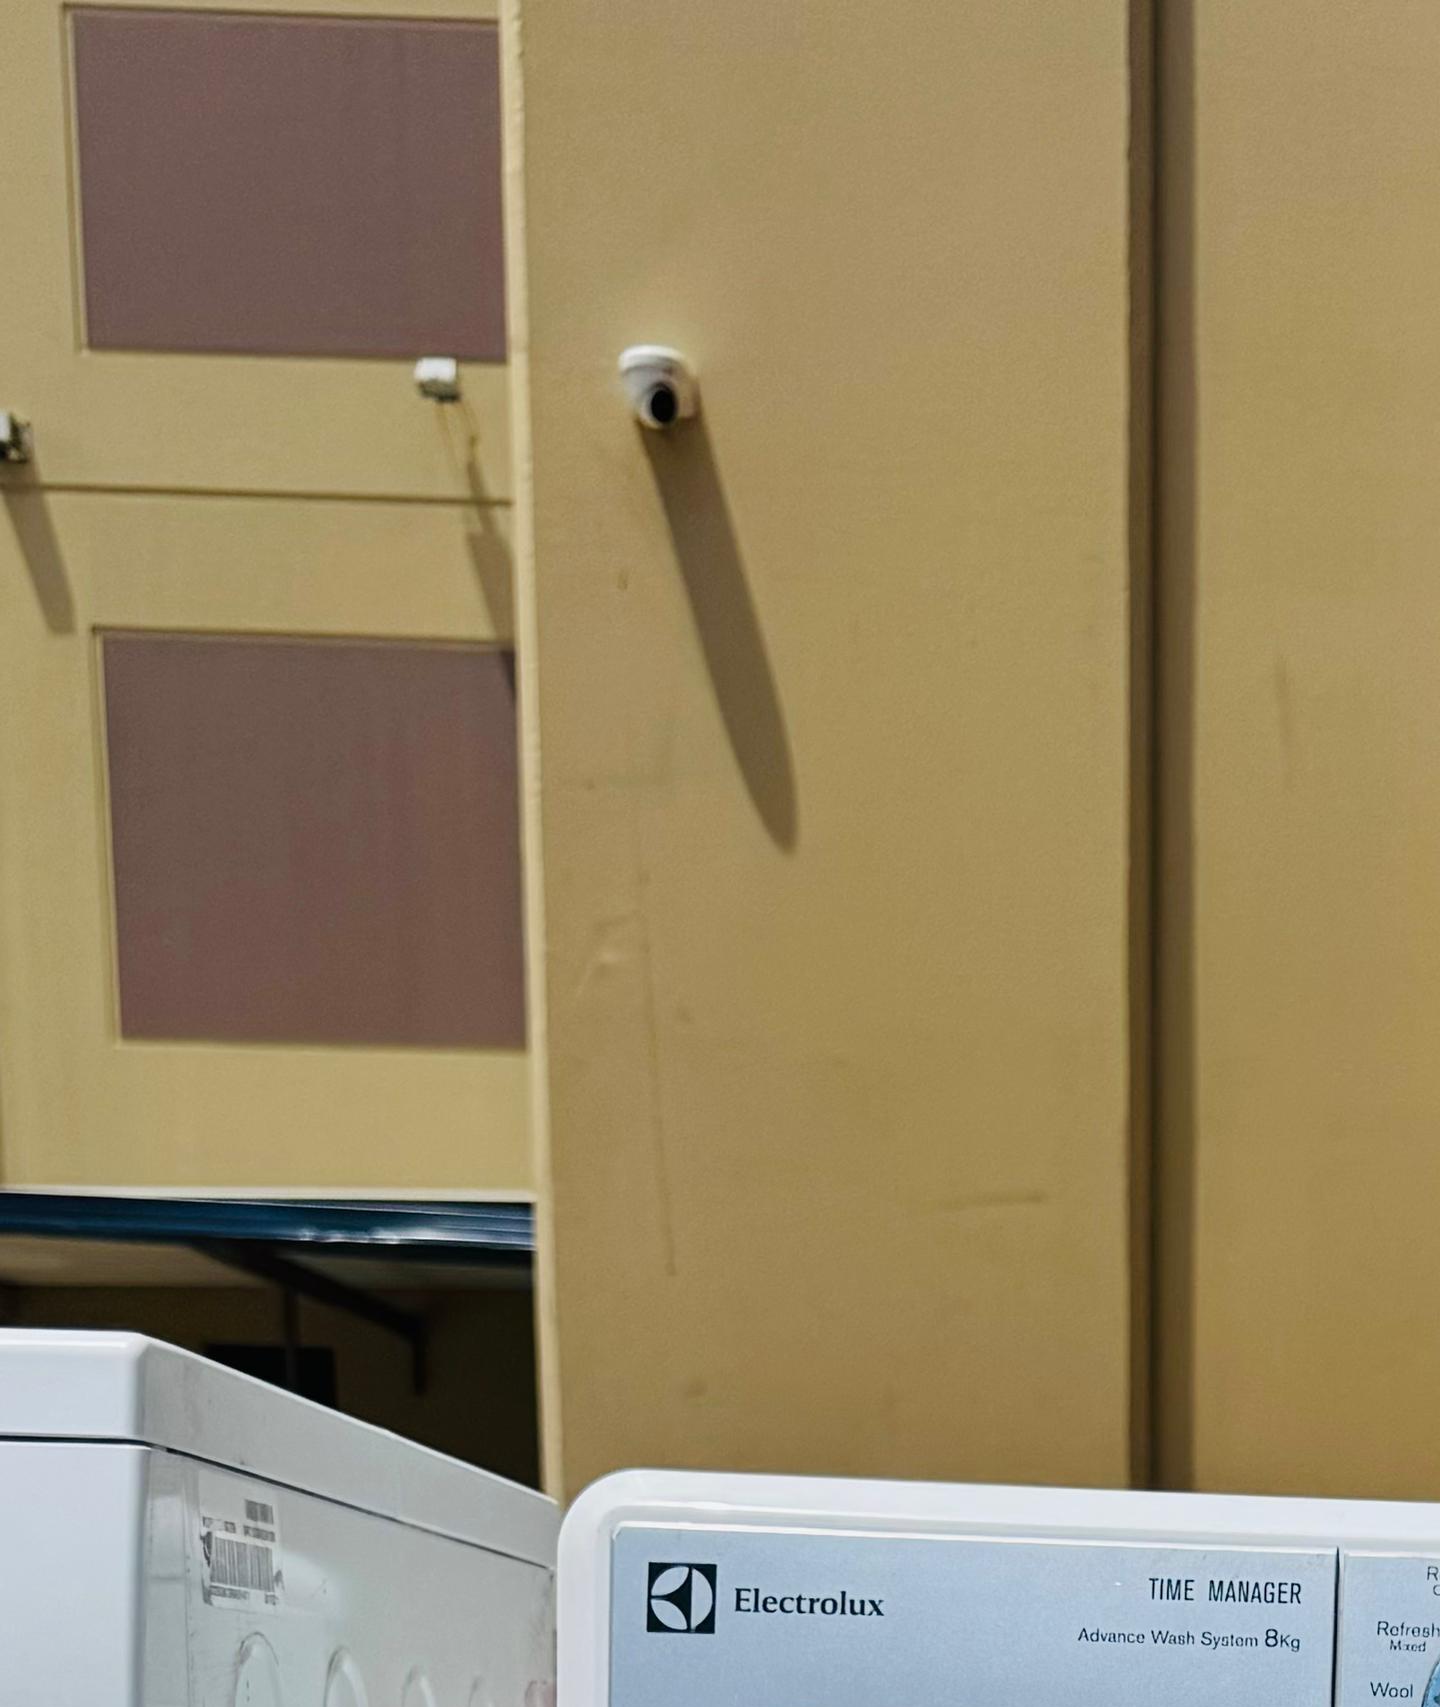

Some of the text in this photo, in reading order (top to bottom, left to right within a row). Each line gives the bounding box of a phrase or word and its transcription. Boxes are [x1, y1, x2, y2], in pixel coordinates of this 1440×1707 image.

[734, 1588, 885, 1617] Electrolux
[1149, 1578, 1301, 1604] TIME MANAGER
[1077, 1628, 1301, 1652] Advance Wash System 8Kg
[1377, 1621, 1440, 1638] Refresh
[1370, 1682, 1413, 1698] Wool
